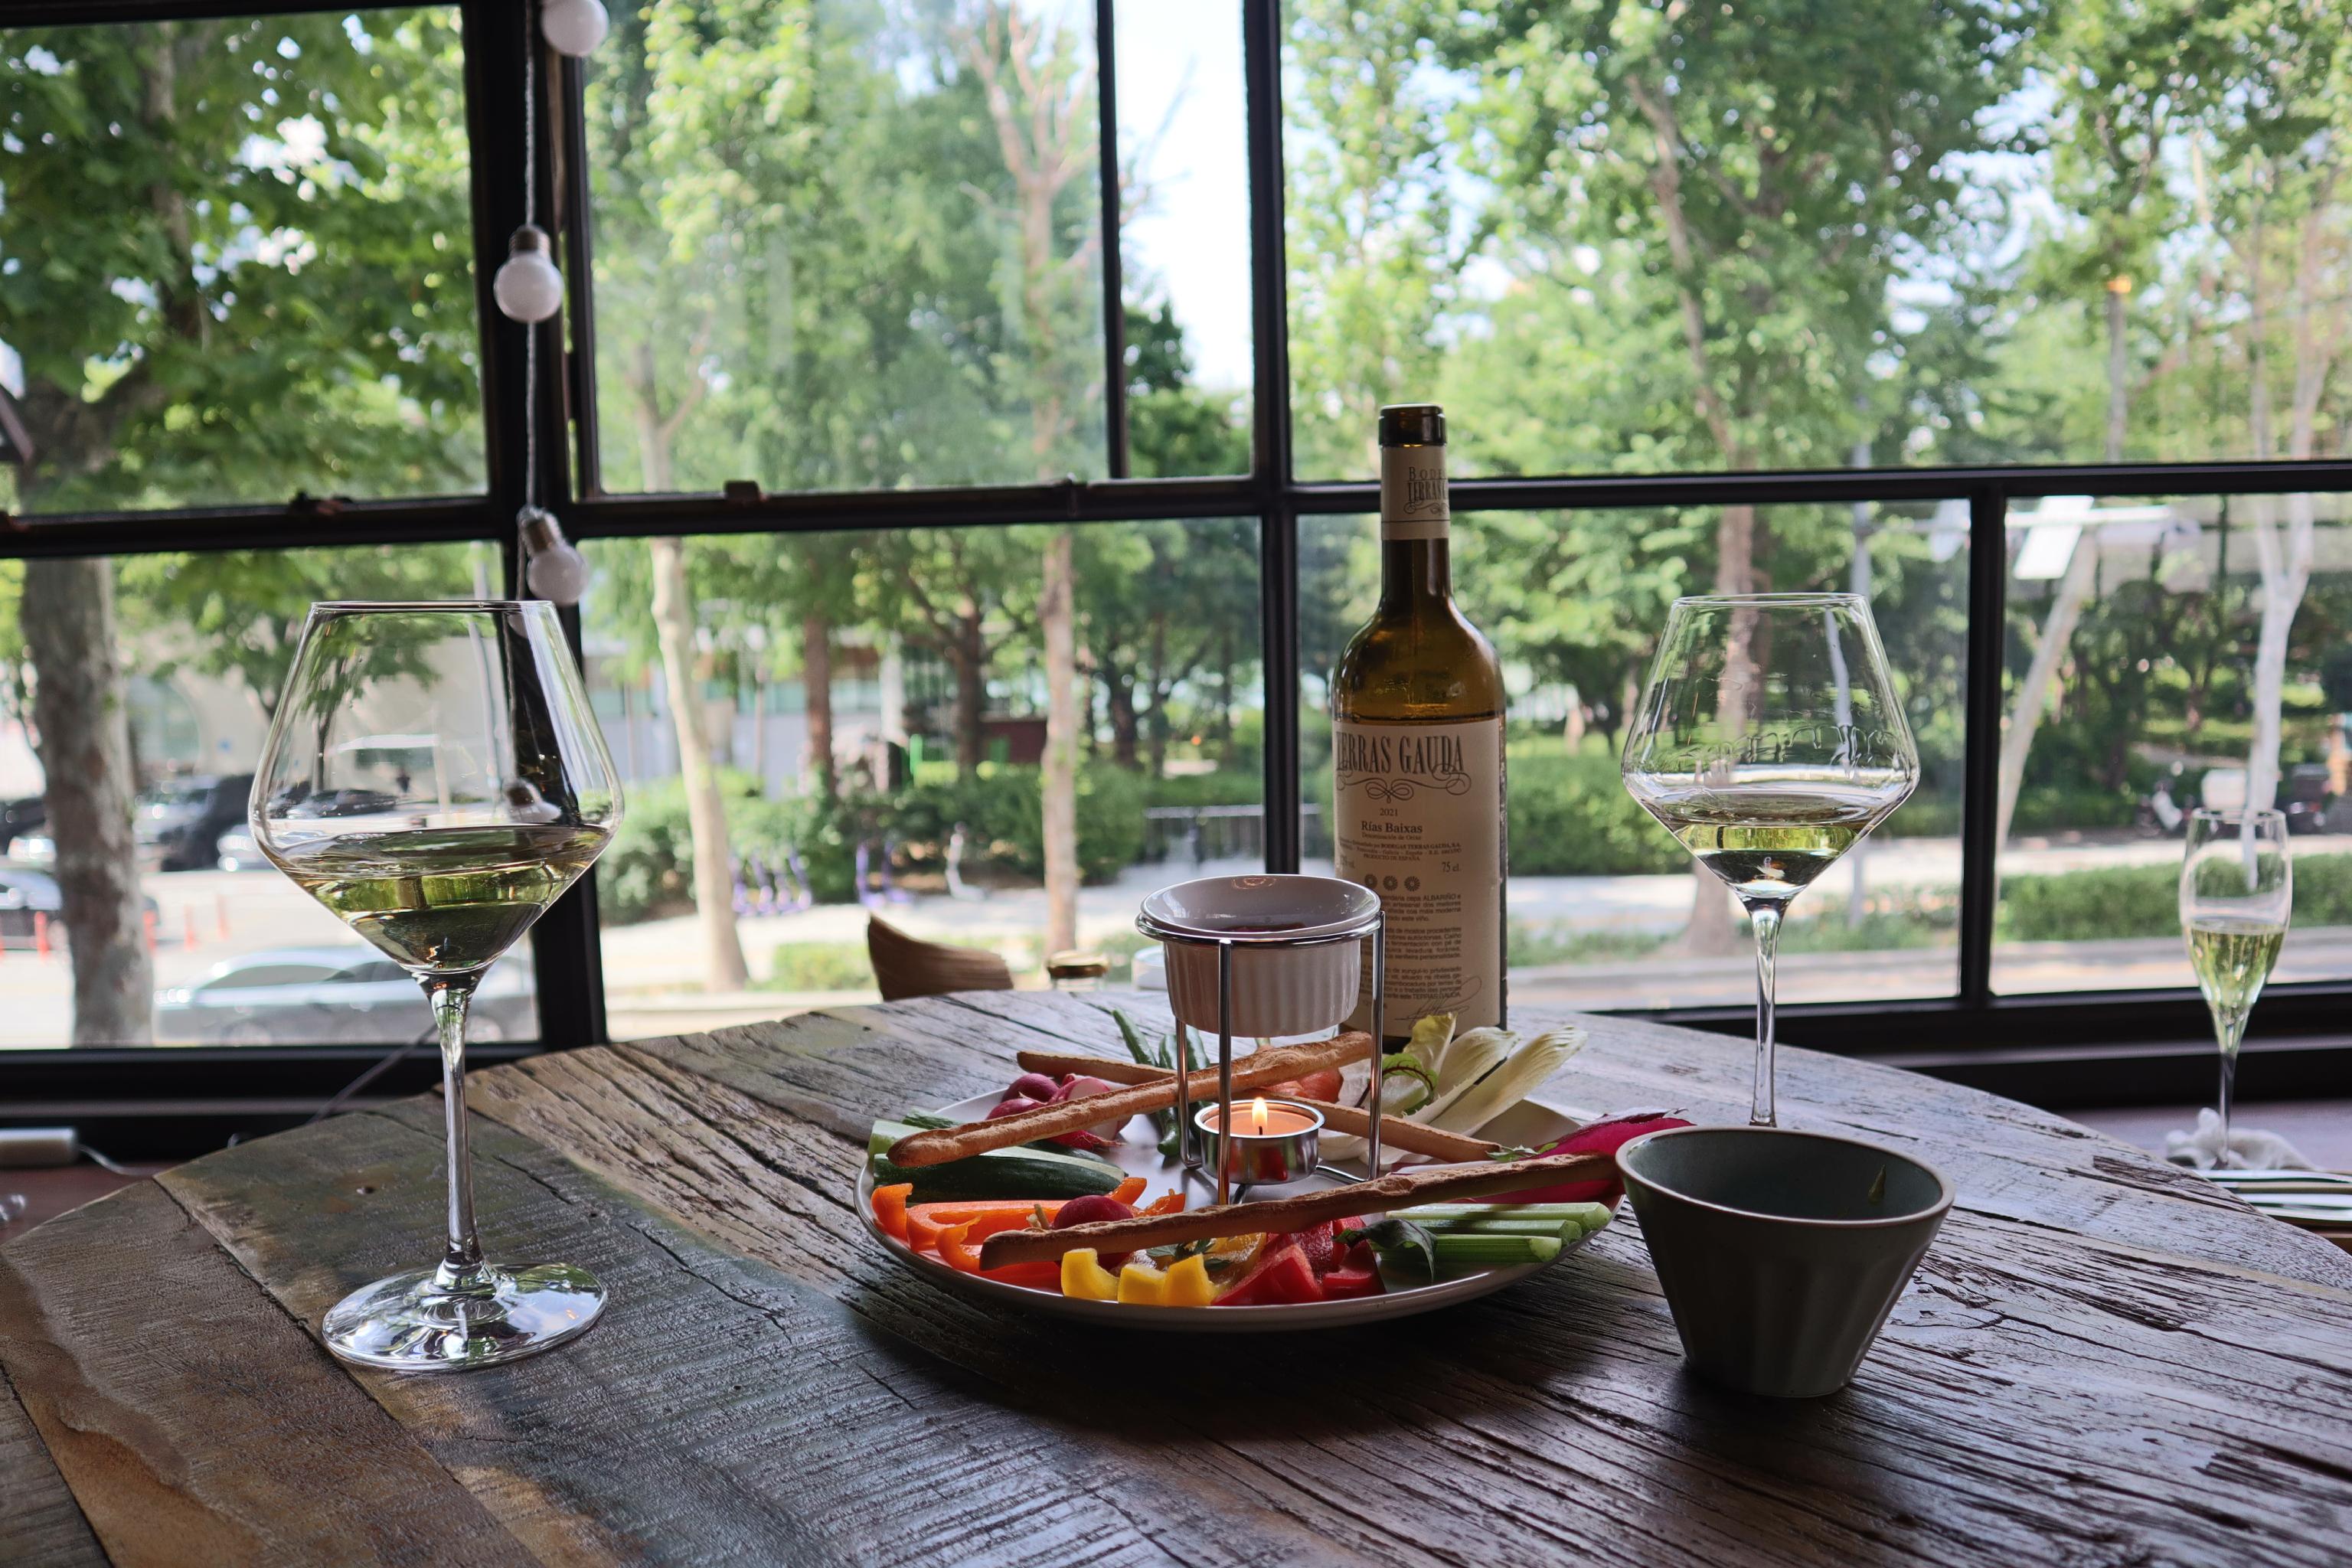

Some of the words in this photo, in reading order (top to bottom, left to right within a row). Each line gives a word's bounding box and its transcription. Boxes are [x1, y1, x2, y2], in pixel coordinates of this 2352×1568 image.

[1336, 731, 1391, 773] TERRAS
[1399, 735, 1464, 774] GAUDA
[1380, 808, 1398, 817] 2021
[1361, 821, 1383, 832] Rías
[1385, 822, 1423, 834] Baixas
[1442, 861, 1451, 873] 75
